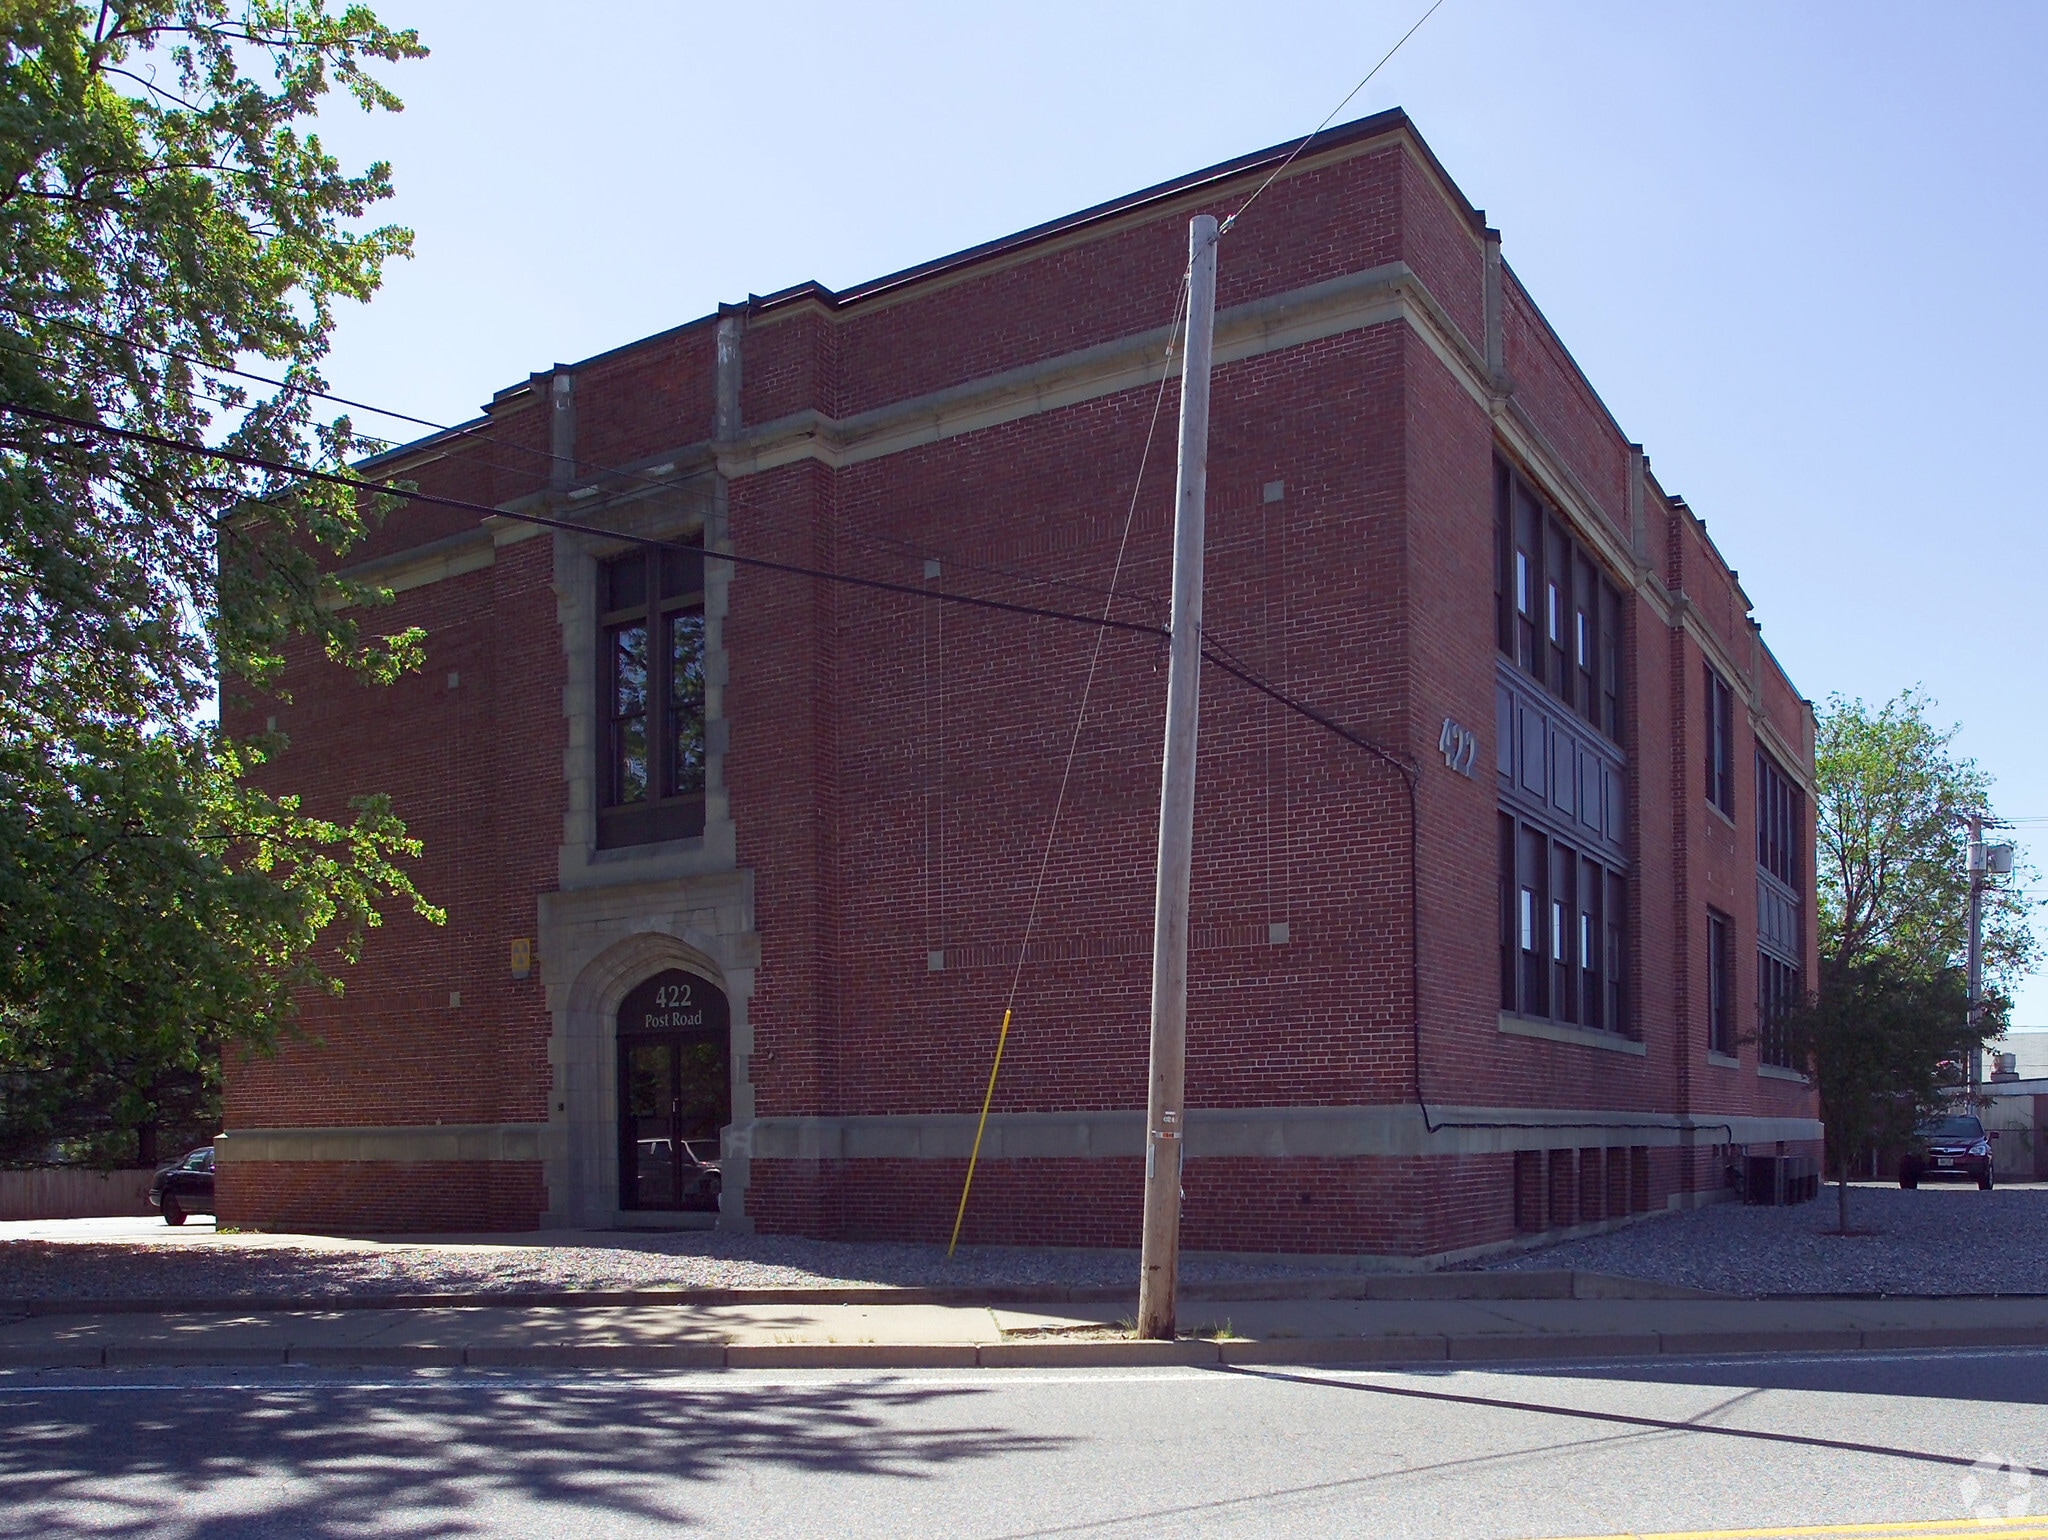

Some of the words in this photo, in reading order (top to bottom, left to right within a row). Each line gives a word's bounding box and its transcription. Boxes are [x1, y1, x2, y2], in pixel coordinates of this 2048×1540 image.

[1439, 718, 1479, 780] 422
[655, 984, 692, 1008] 422
[645, 1013, 669, 1028] Post
[672, 1010, 702, 1026] Road
